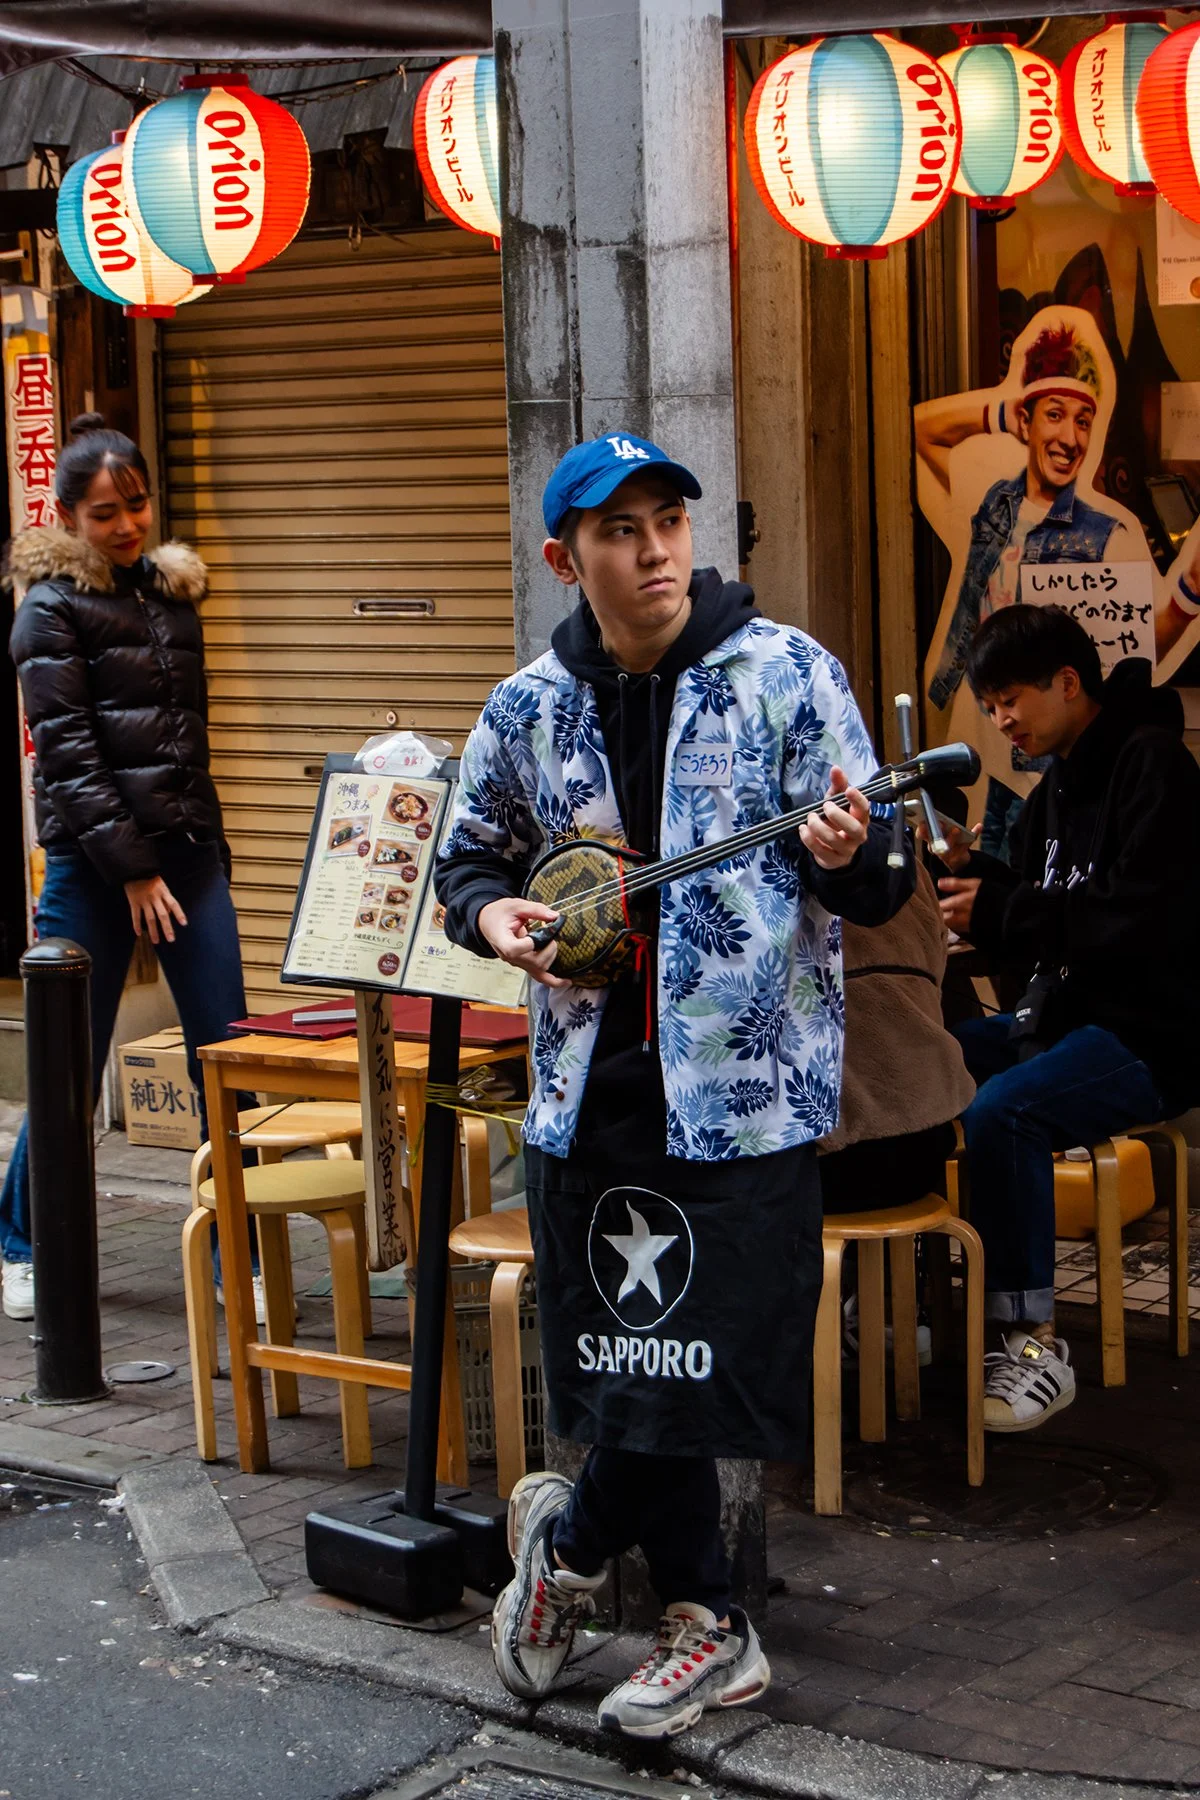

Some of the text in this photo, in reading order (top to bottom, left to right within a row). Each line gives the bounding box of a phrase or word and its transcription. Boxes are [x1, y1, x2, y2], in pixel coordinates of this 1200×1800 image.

[1090, 48, 1112, 152] オリオンビール
[440, 76, 474, 203] オリオンビール
[773, 70, 805, 207] オリオンビール
[606, 436, 650, 460] LA
[680, 753, 728, 775] こうたろう
[337, 782, 359, 798] 沖縄
[342, 799, 370, 812] つまみ
[130, 1077, 187, 1115] 純氷
[577, 1333, 712, 1379] SAPPORO
